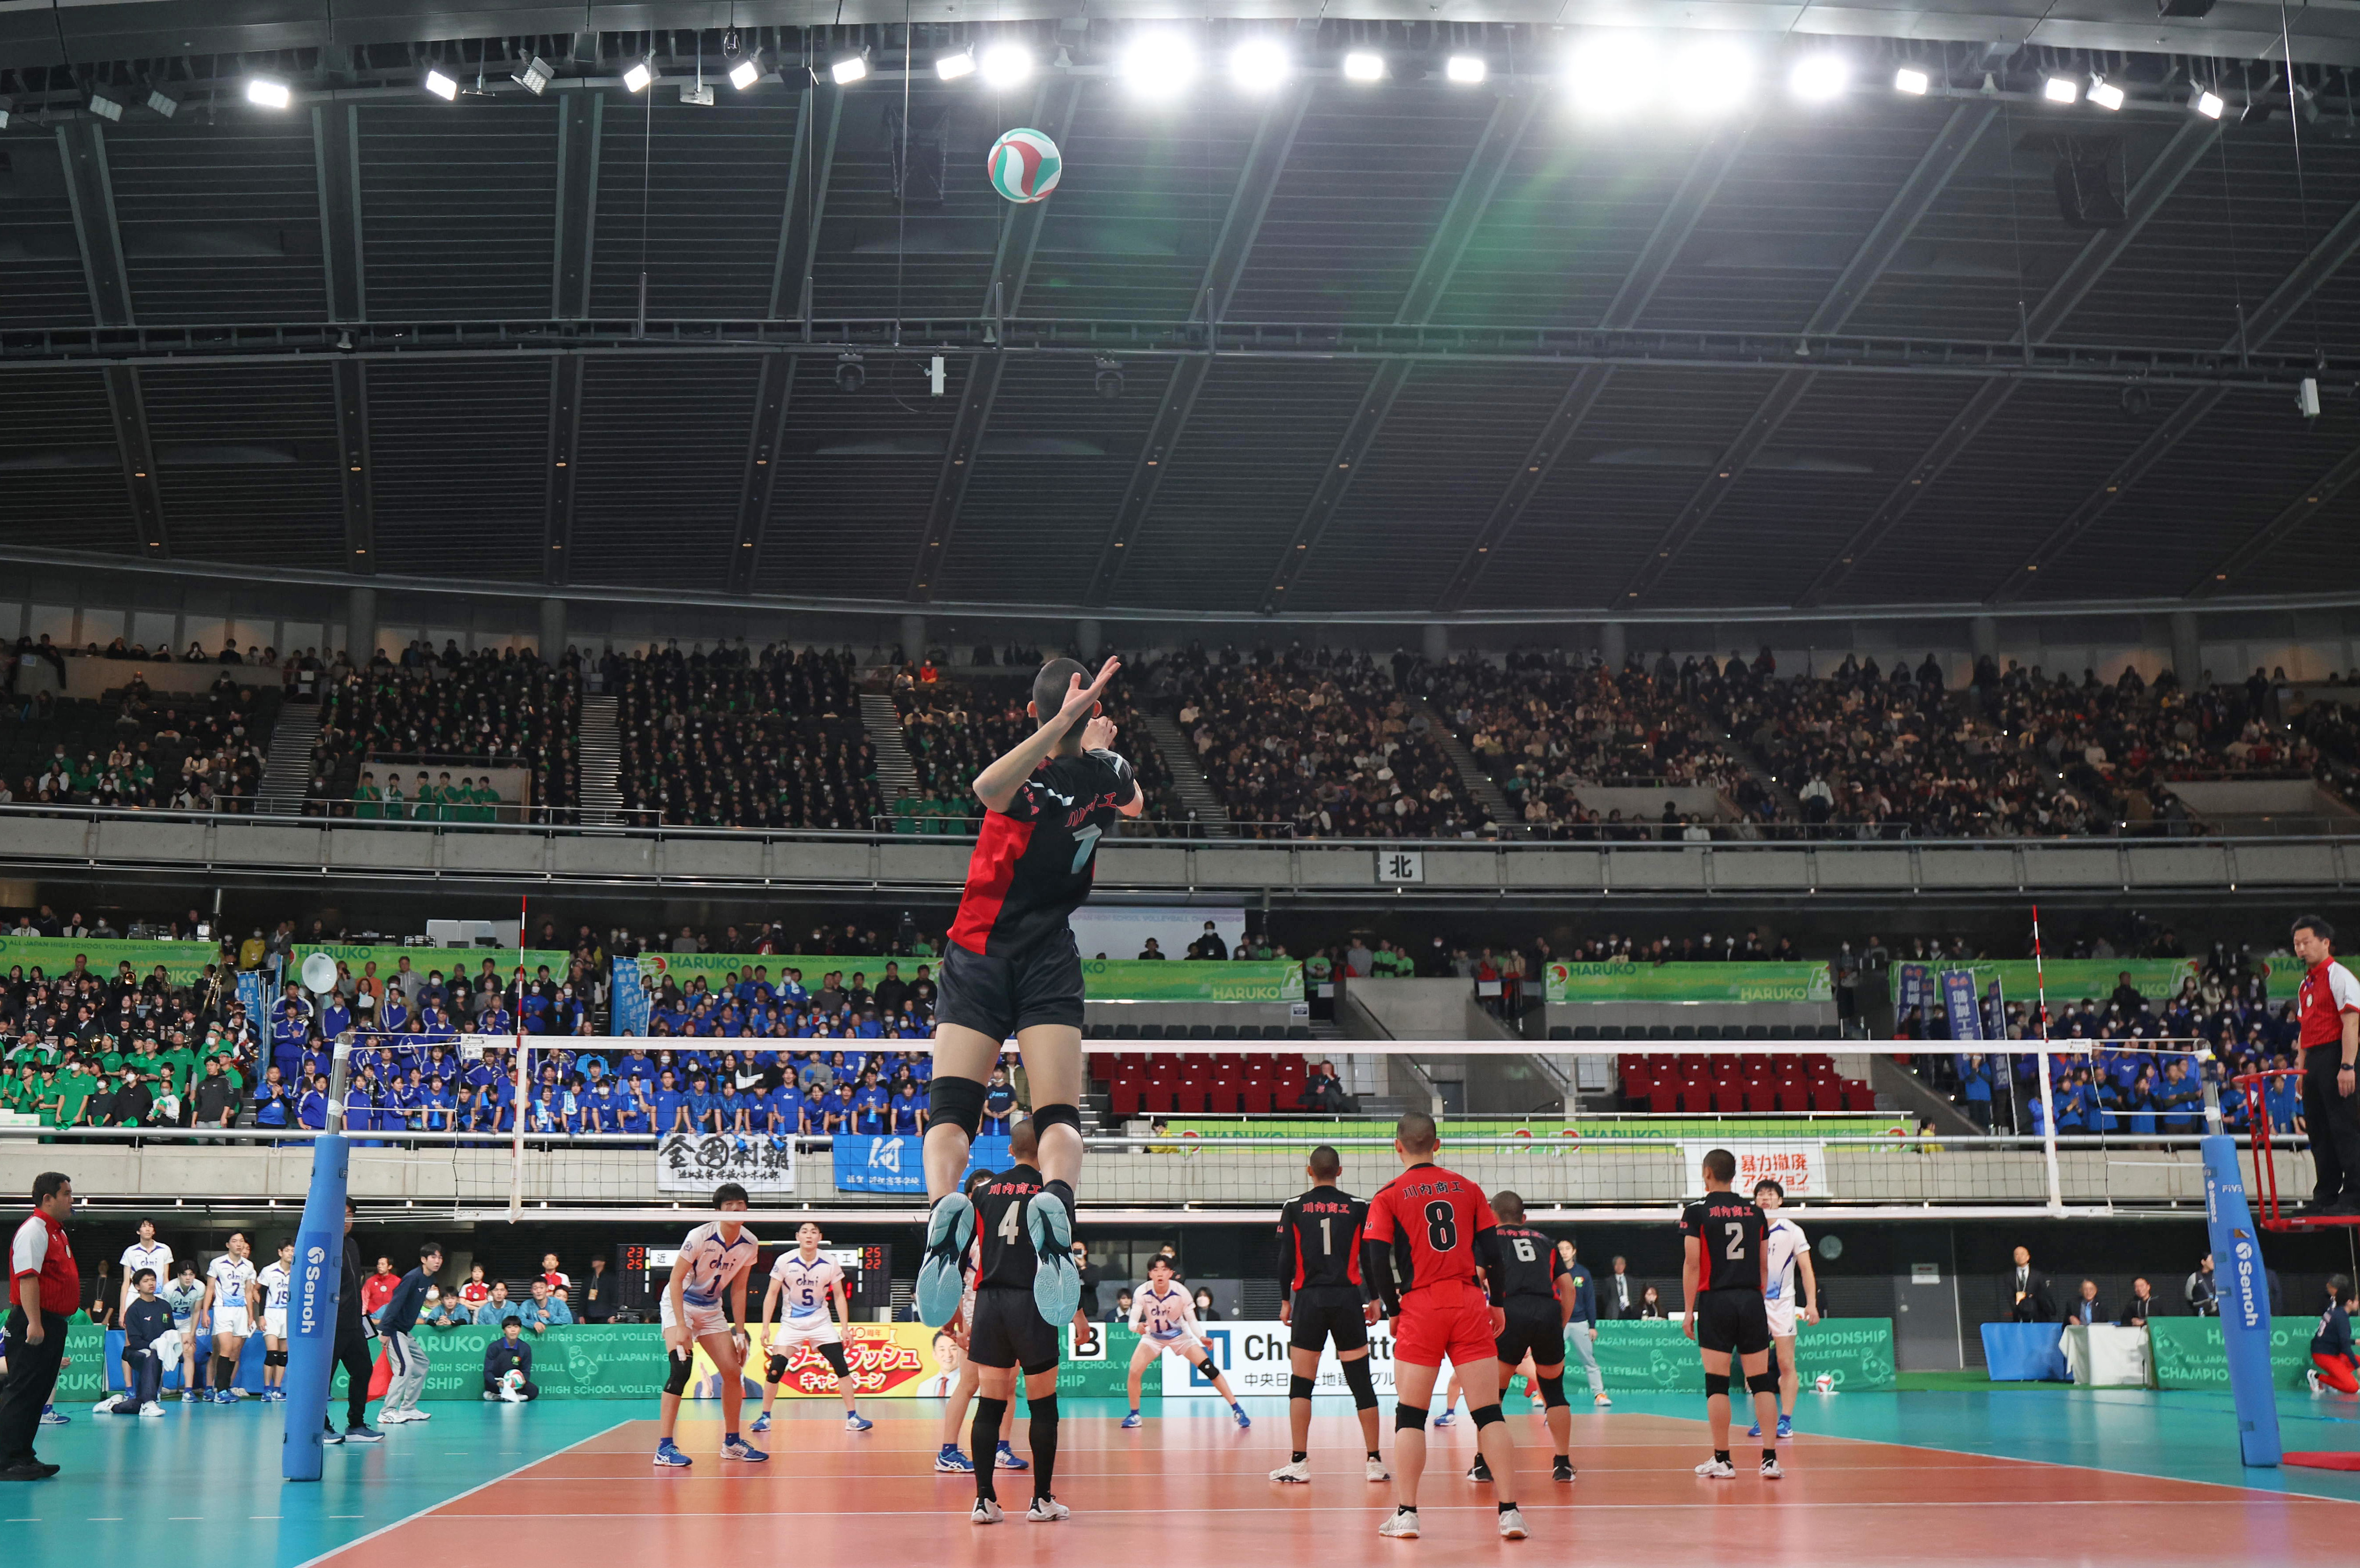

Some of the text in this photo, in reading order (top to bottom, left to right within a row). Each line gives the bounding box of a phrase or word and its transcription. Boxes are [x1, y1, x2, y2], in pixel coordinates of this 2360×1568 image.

[1071, 823, 1102, 874] 7
[1389, 855, 1412, 878] 北
[669, 956, 741, 969] HARUKO
[1569, 962, 1636, 976] HARUKO
[1213, 986, 1279, 999] HARUKO
[1741, 987, 1808, 1000] HARUKO
[1741, 1153, 1808, 1172] 暴力撤廃
[987, 1182, 1042, 1195] 川内商工
[1403, 1180, 1465, 1200] 川内商工
[1302, 1201, 1351, 1214] 川内商工
[998, 1201, 1021, 1245] 4
[1424, 1200, 1457, 1252] 8
[1320, 1217, 1332, 1255] 1
[1725, 1222, 1745, 1260] 2
[627, 1247, 645, 1257] 23
[865, 1247, 882, 1257] 25
[1512, 1238, 1537, 1262] 6
[627, 1259, 644, 1269] 25
[865, 1259, 882, 1269] 22
[232, 1282, 240, 1296] 7
[706, 1274, 722, 1295] 1
[301, 1265, 321, 1333] Senoh
[802, 1288, 814, 1306] 5
[2238, 1261, 2259, 1326] Senoh
[1155, 1319, 1173, 1334] 11
[2292, 1328, 2308, 1337] ALL
[548, 1333, 573, 1342] HIGH
[576, 1333, 619, 1342] SCHOOL
[1075, 1327, 1100, 1356] B
[1594, 1337, 1697, 1347] JAPAN HIGH SCHOOL
[596, 1353, 615, 1362] ALL
[616, 1353, 650, 1362] JAPAN
[1800, 1349, 1858, 1361] VOLLEYBALL
[2185, 1355, 2200, 1364] ALL
[1077, 1361, 1119, 1370] SCHOOL
[1677, 1358, 1694, 1366] ALL
[545, 1386, 570, 1394] HIGH
[574, 1385, 617, 1394] SCHOOL
